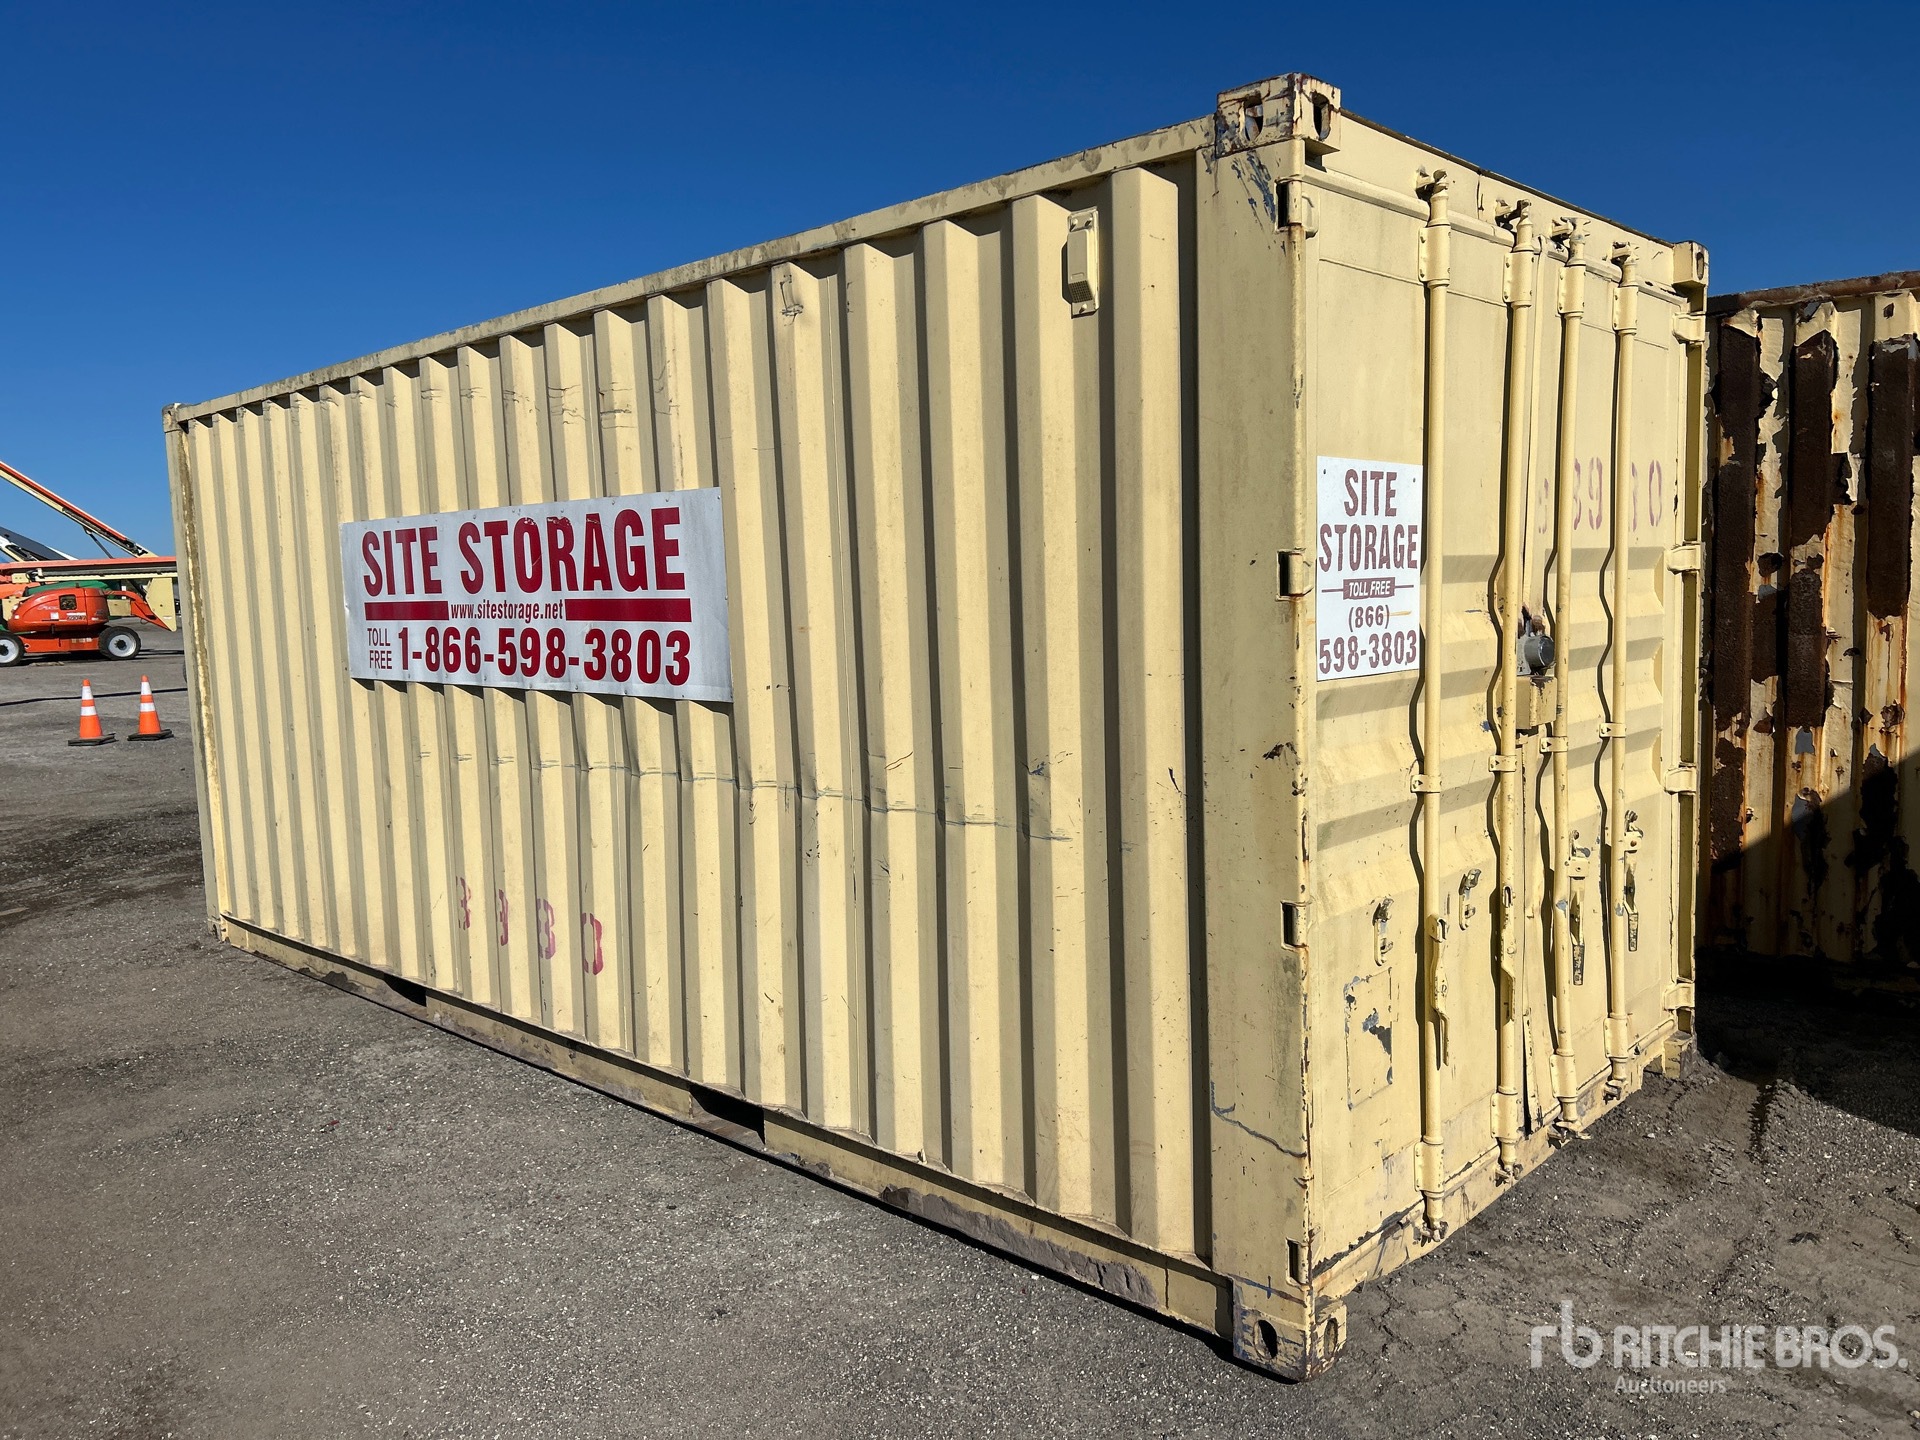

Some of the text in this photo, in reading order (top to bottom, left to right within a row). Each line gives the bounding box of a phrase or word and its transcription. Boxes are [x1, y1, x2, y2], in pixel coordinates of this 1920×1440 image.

[1343, 468, 1398, 518] SITE
[361, 506, 686, 598] SITE STORAGE
[1318, 523, 1418, 573] STORAGE
[1349, 580, 1391, 597] TOLL FREE
[450, 599, 563, 624] www.sitestorage.net
[1348, 604, 1390, 633] (866)
[366, 627, 391, 648] TOLL
[398, 626, 691, 686] 1-866-598-3803
[1318, 629, 1418, 675] 598-3803
[368, 649, 393, 671] FREE
